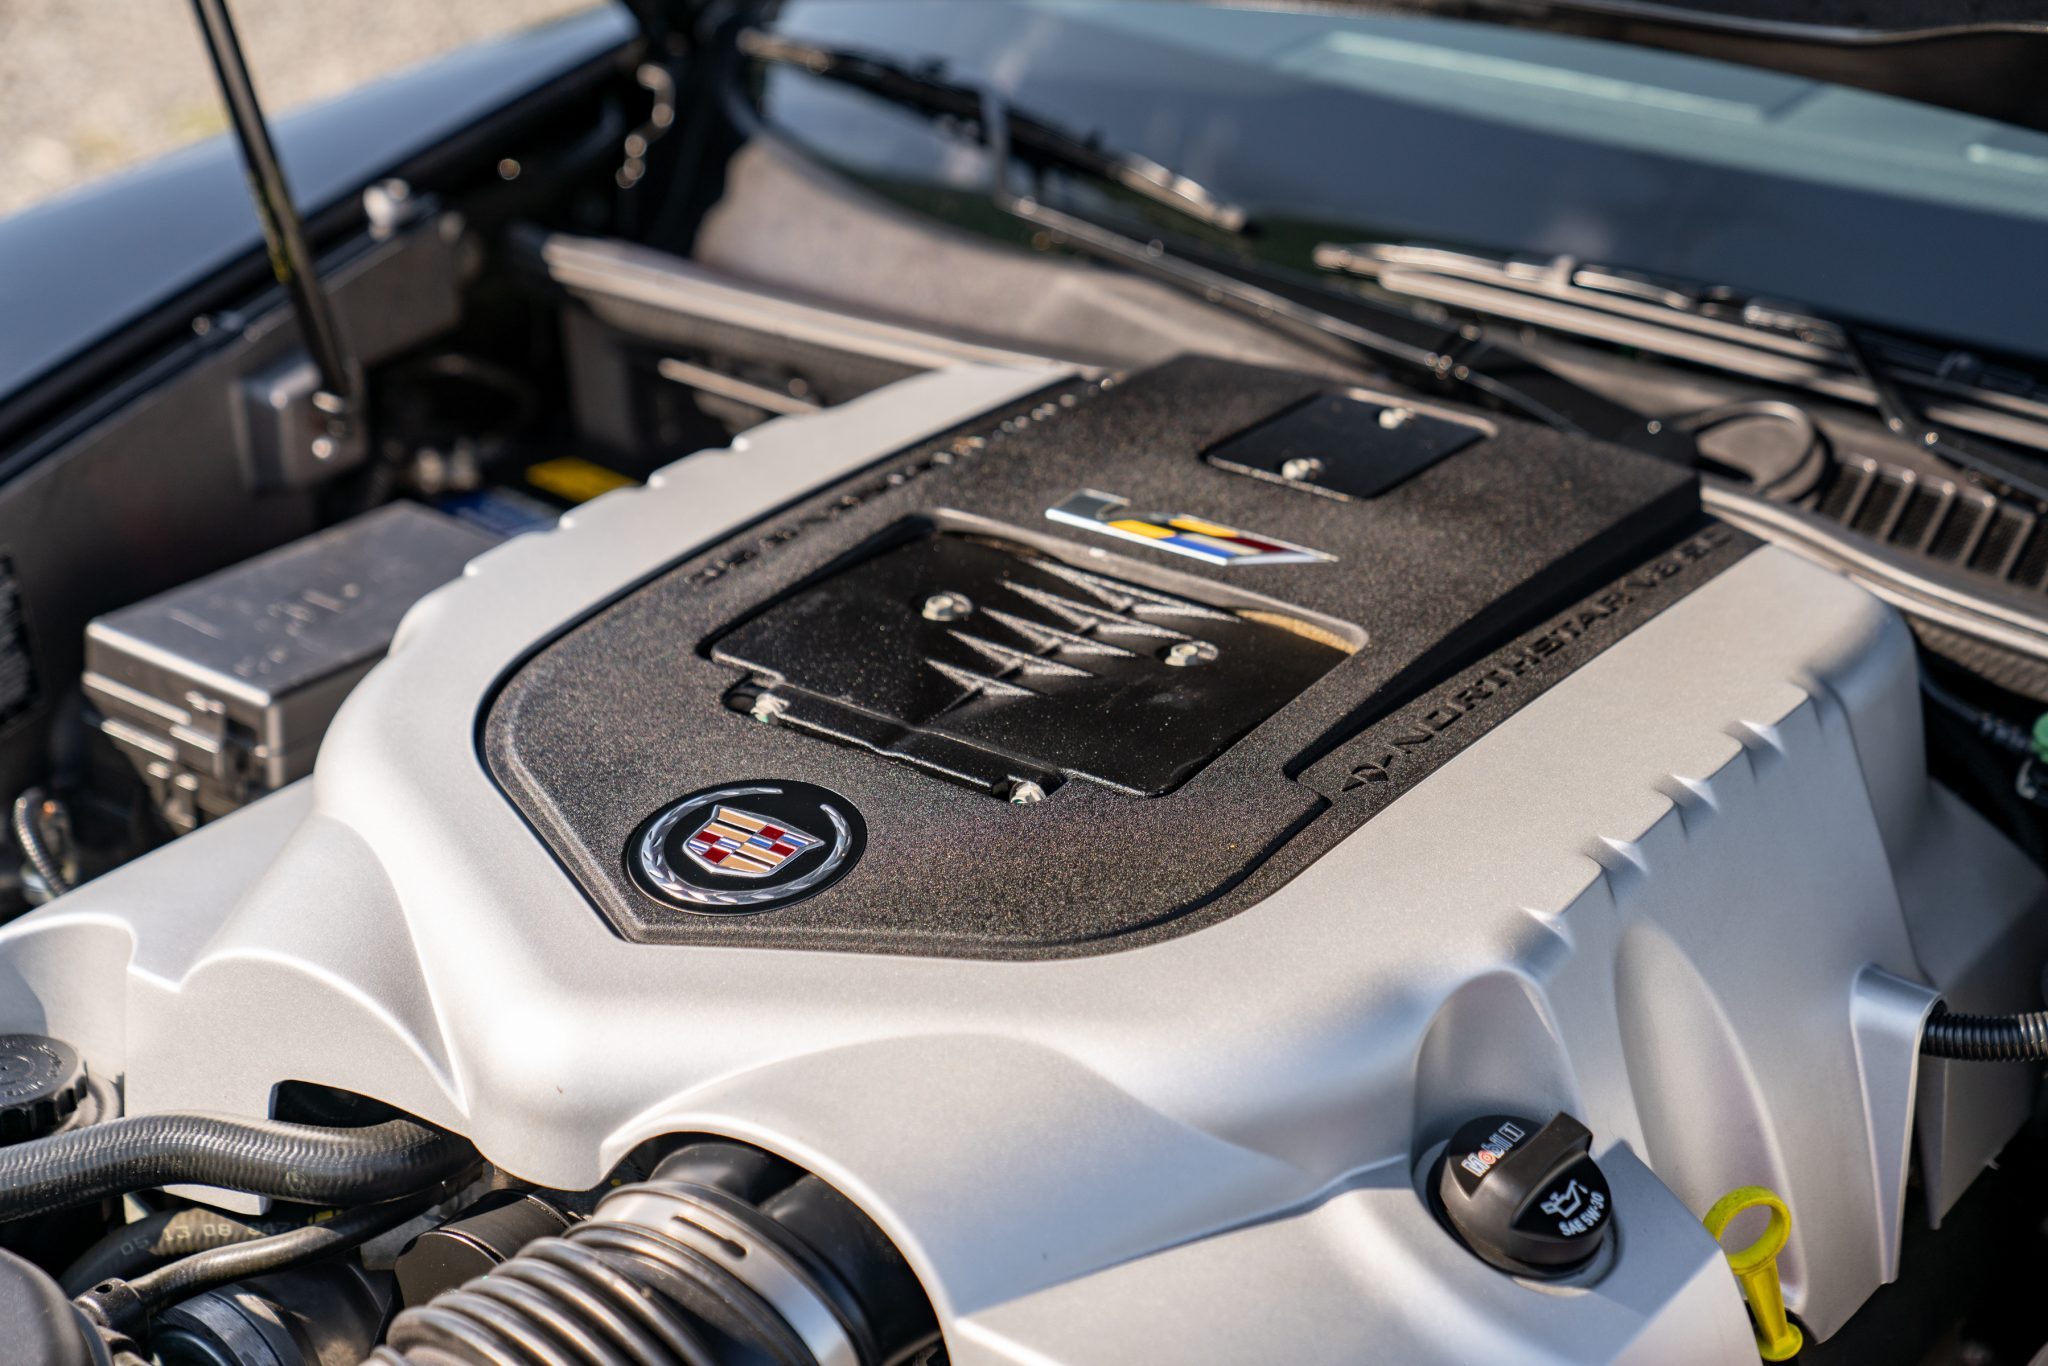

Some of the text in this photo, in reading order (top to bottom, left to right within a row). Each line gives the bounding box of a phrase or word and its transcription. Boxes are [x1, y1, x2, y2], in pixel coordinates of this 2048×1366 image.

[1390, 587, 1635, 756] NORTHSTAR
[1461, 1123, 1523, 1178] Mobil 1
[1558, 1191, 1605, 1237] SAE 5W-30
[120, 1234, 150, 1256] 05
[164, 1225, 191, 1242] 13
[202, 1223, 233, 1237] 08
